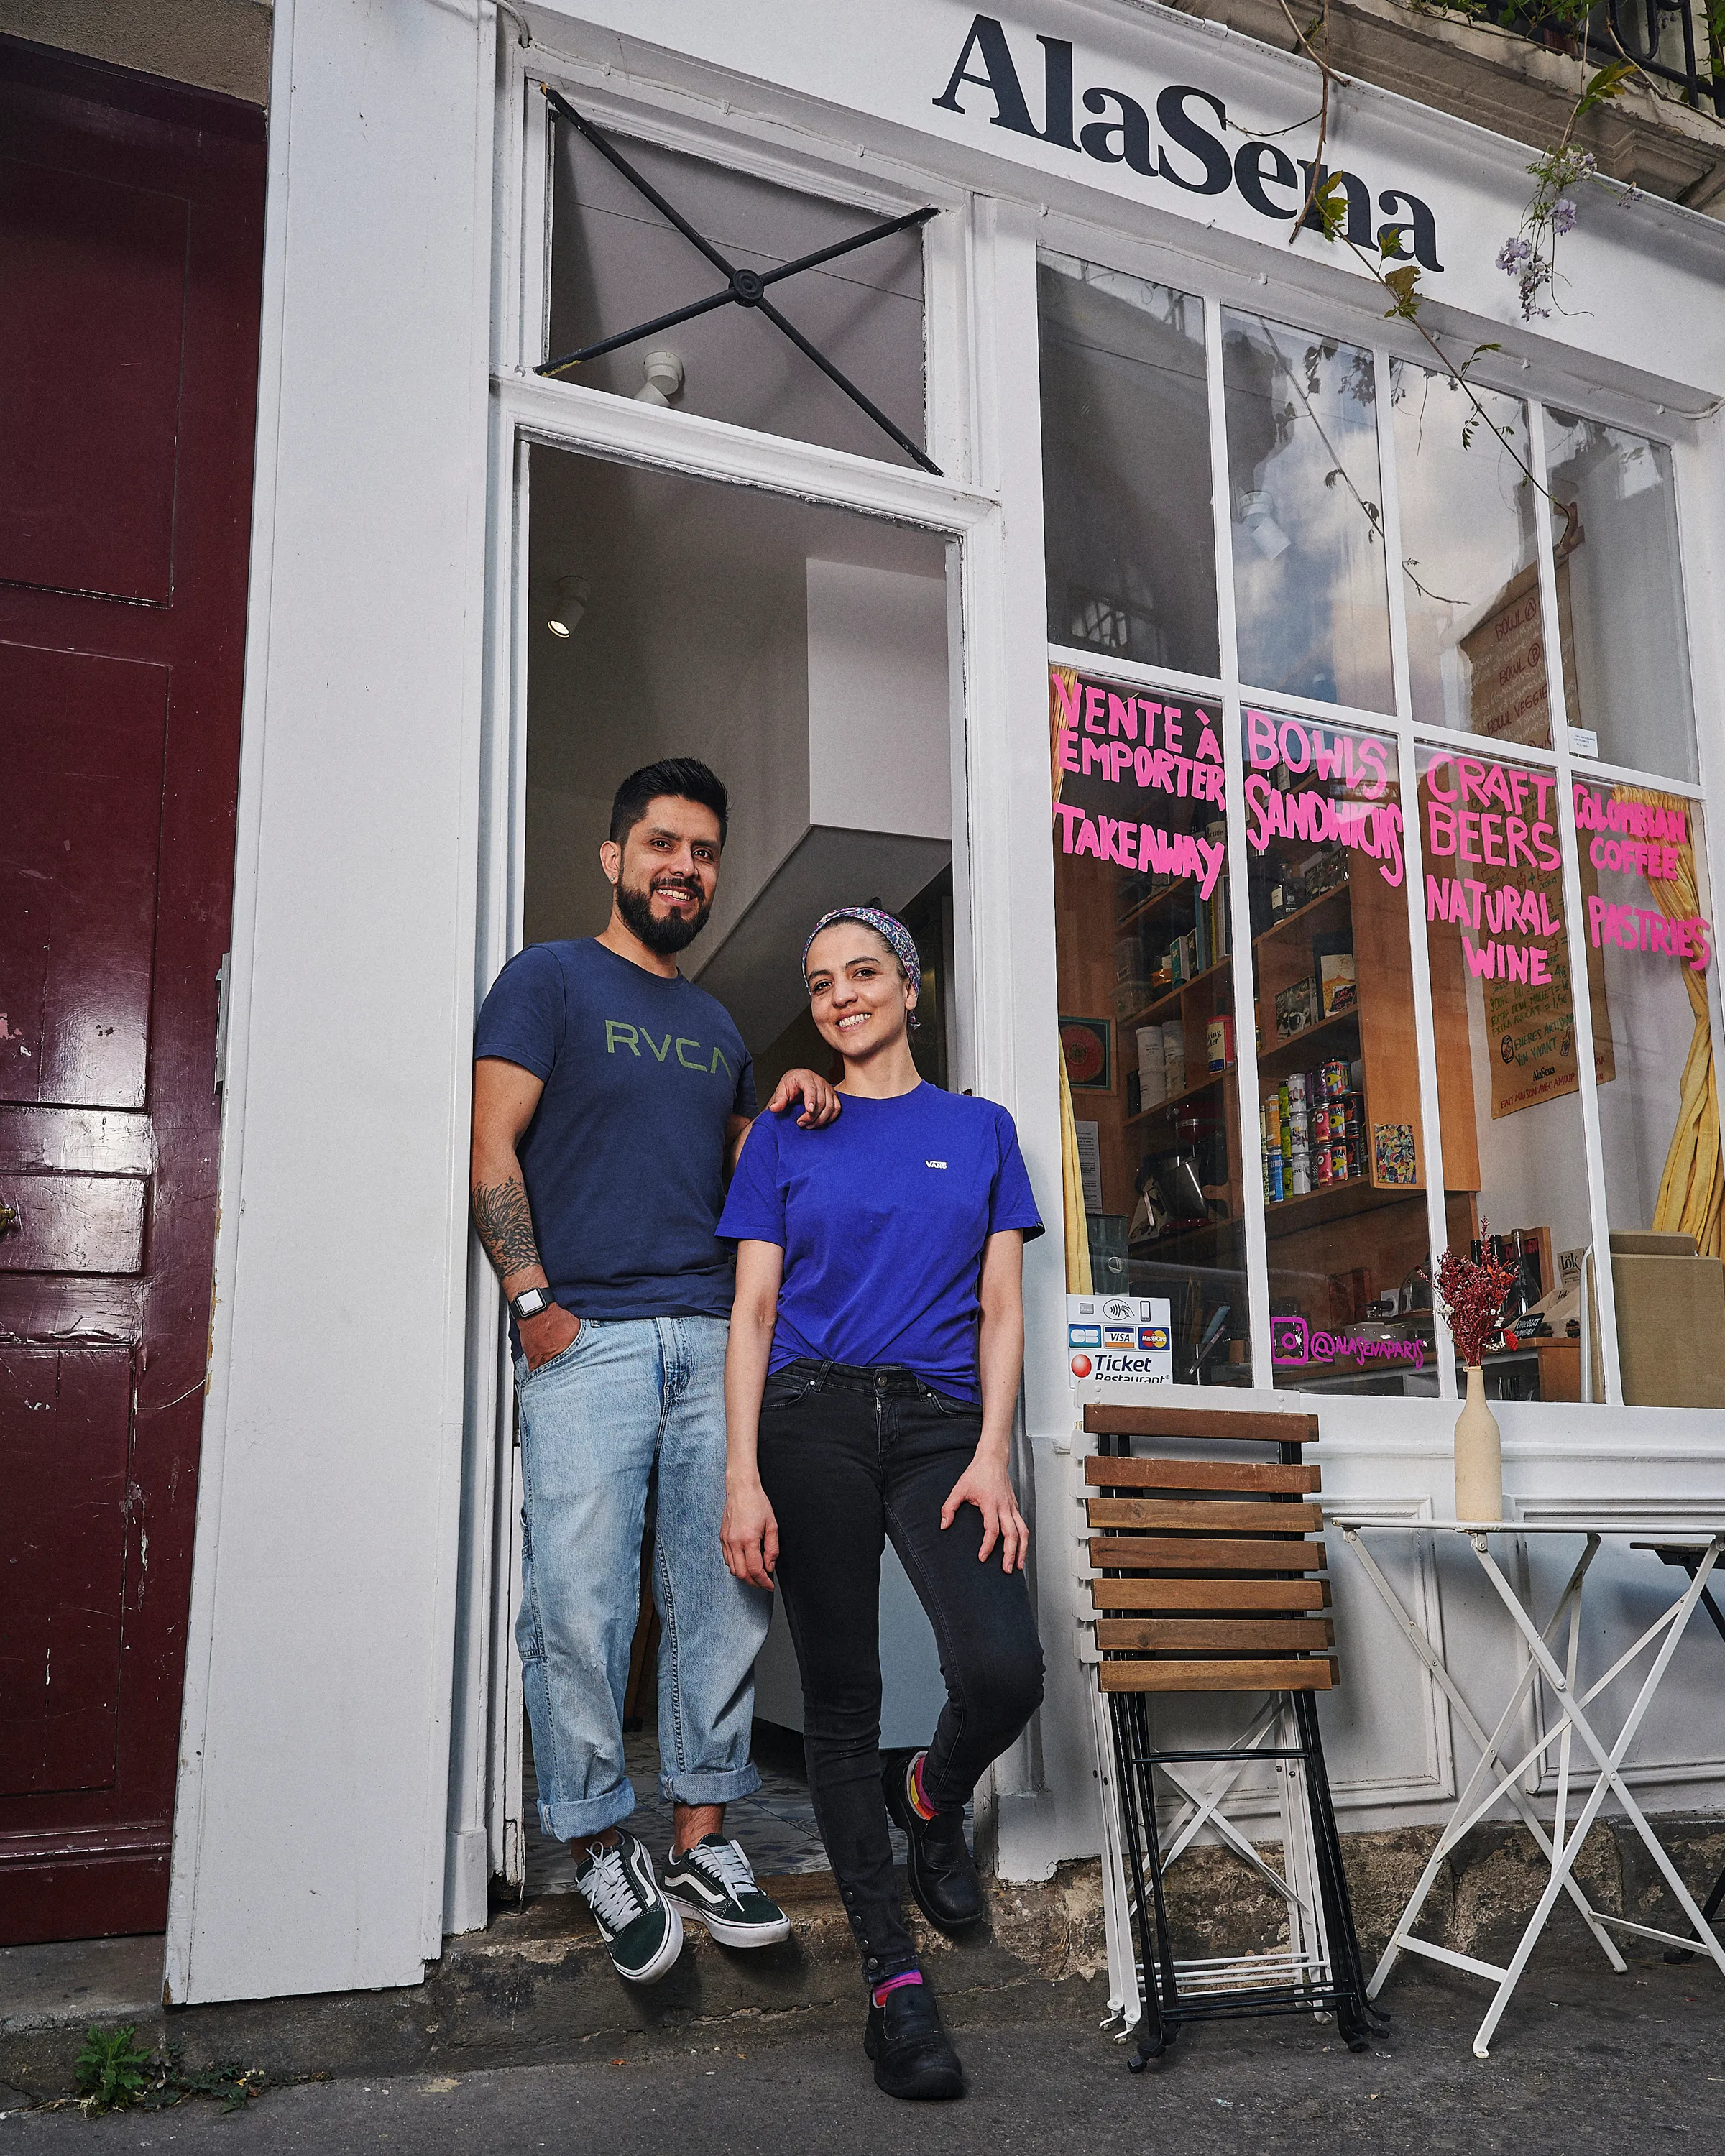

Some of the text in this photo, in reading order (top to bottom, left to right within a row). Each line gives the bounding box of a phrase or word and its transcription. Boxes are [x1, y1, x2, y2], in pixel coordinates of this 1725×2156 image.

[932, 13, 1445, 272] AlaSena
[1495, 609, 1524, 642] BOWL
[1499, 658, 1525, 686] BOWL
[1052, 673, 1223, 763] VENTE À
[1514, 683, 1547, 717] VEGGIE
[1058, 727, 1226, 812] EMPORTER
[1247, 710, 1388, 801] BOWLS
[1426, 751, 1556, 821] CRAFT
[1427, 801, 1562, 872] BEERS
[1572, 783, 1686, 844] COLOMBIAN
[1052, 801, 1225, 901] TAKEAWAY
[1589, 836, 1679, 881] COFFEE
[1426, 874, 1560, 937] NATURAL
[1588, 895, 1711, 971] PASTRIES
[1462, 936, 1552, 986] WINE
[605, 1019, 732, 1081] RVCA
[1514, 1028, 1542, 1051] BIÈRES
[1514, 1037, 1557, 1067] VIN VIVANT
[1500, 1072, 1576, 1109] FAIT MAISON AVEC AMOUR
[1533, 1066, 1555, 1082] AlaSena
[925, 1160, 947, 1169] VANS
[1560, 1253, 1581, 1271] lök
[1110, 1333, 1130, 1342] VISA
[1095, 1355, 1151, 1372] Ticket
